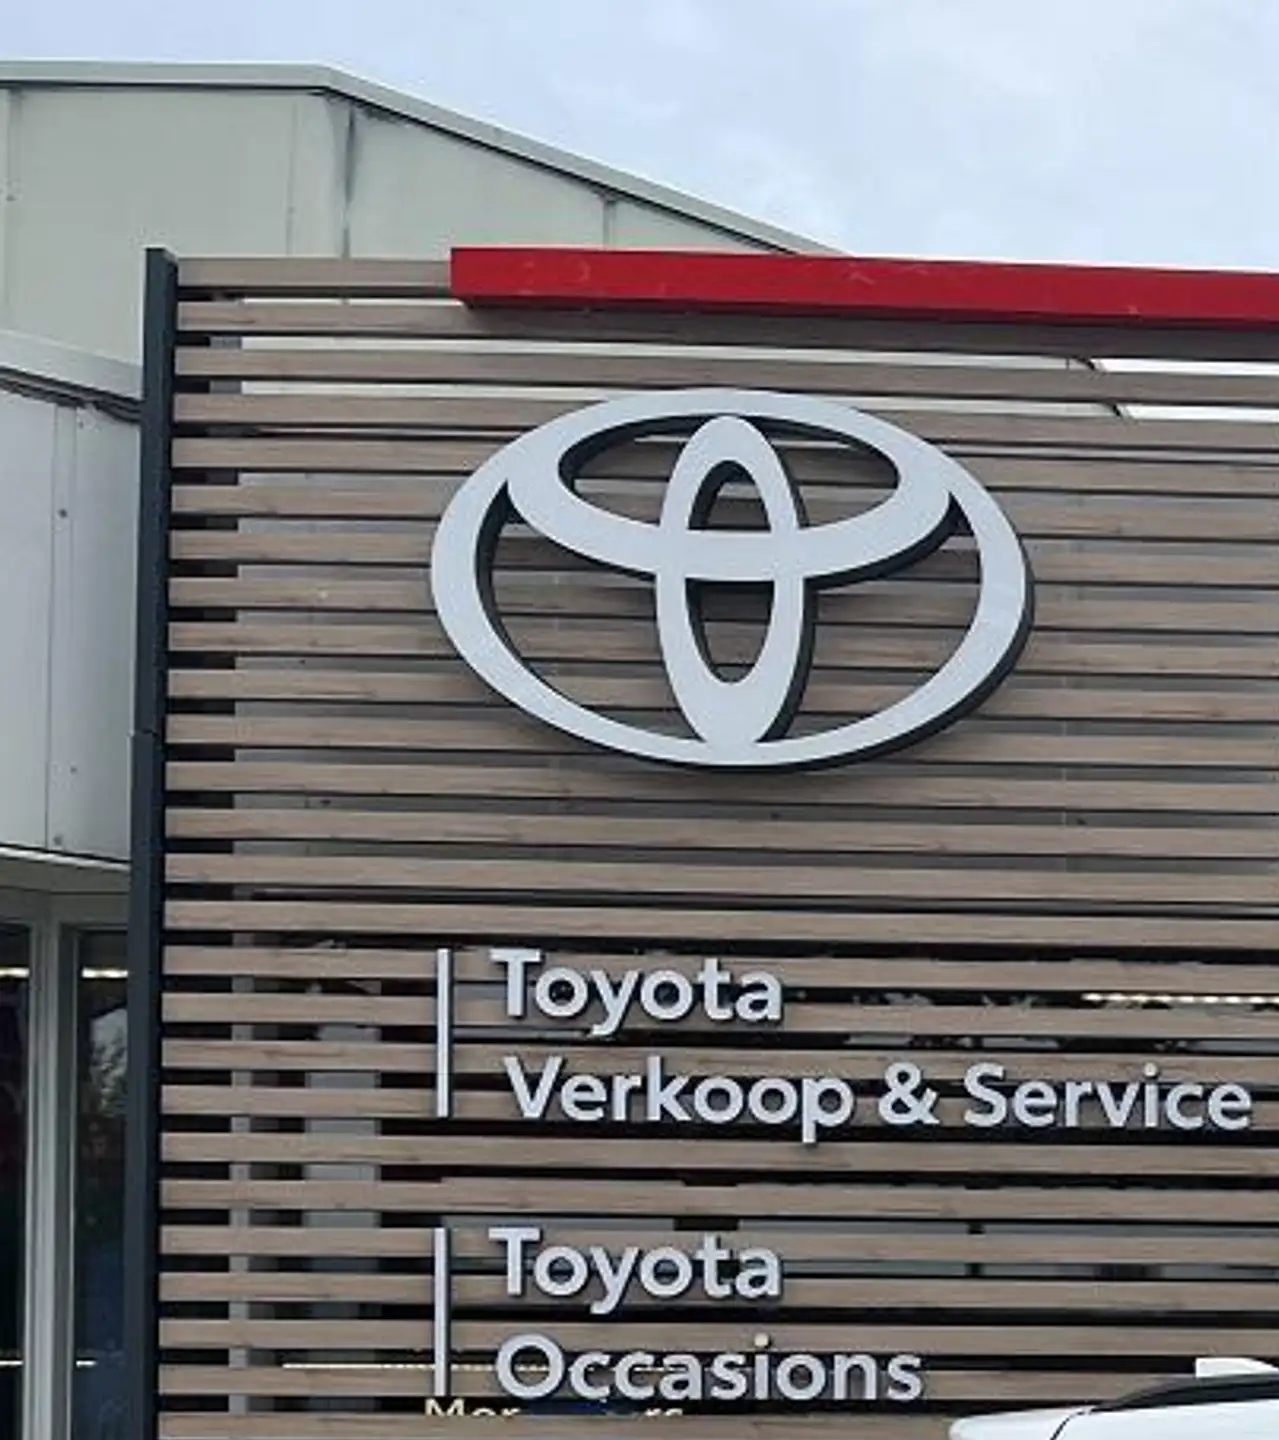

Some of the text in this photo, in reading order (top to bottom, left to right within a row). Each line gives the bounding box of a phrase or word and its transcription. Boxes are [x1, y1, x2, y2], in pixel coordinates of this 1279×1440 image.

[490, 948, 782, 1036] Toyota
[503, 1055, 1253, 1144] Verkoop & Service
[488, 1227, 782, 1315] Toyota
[495, 1334, 922, 1402] Occasions
